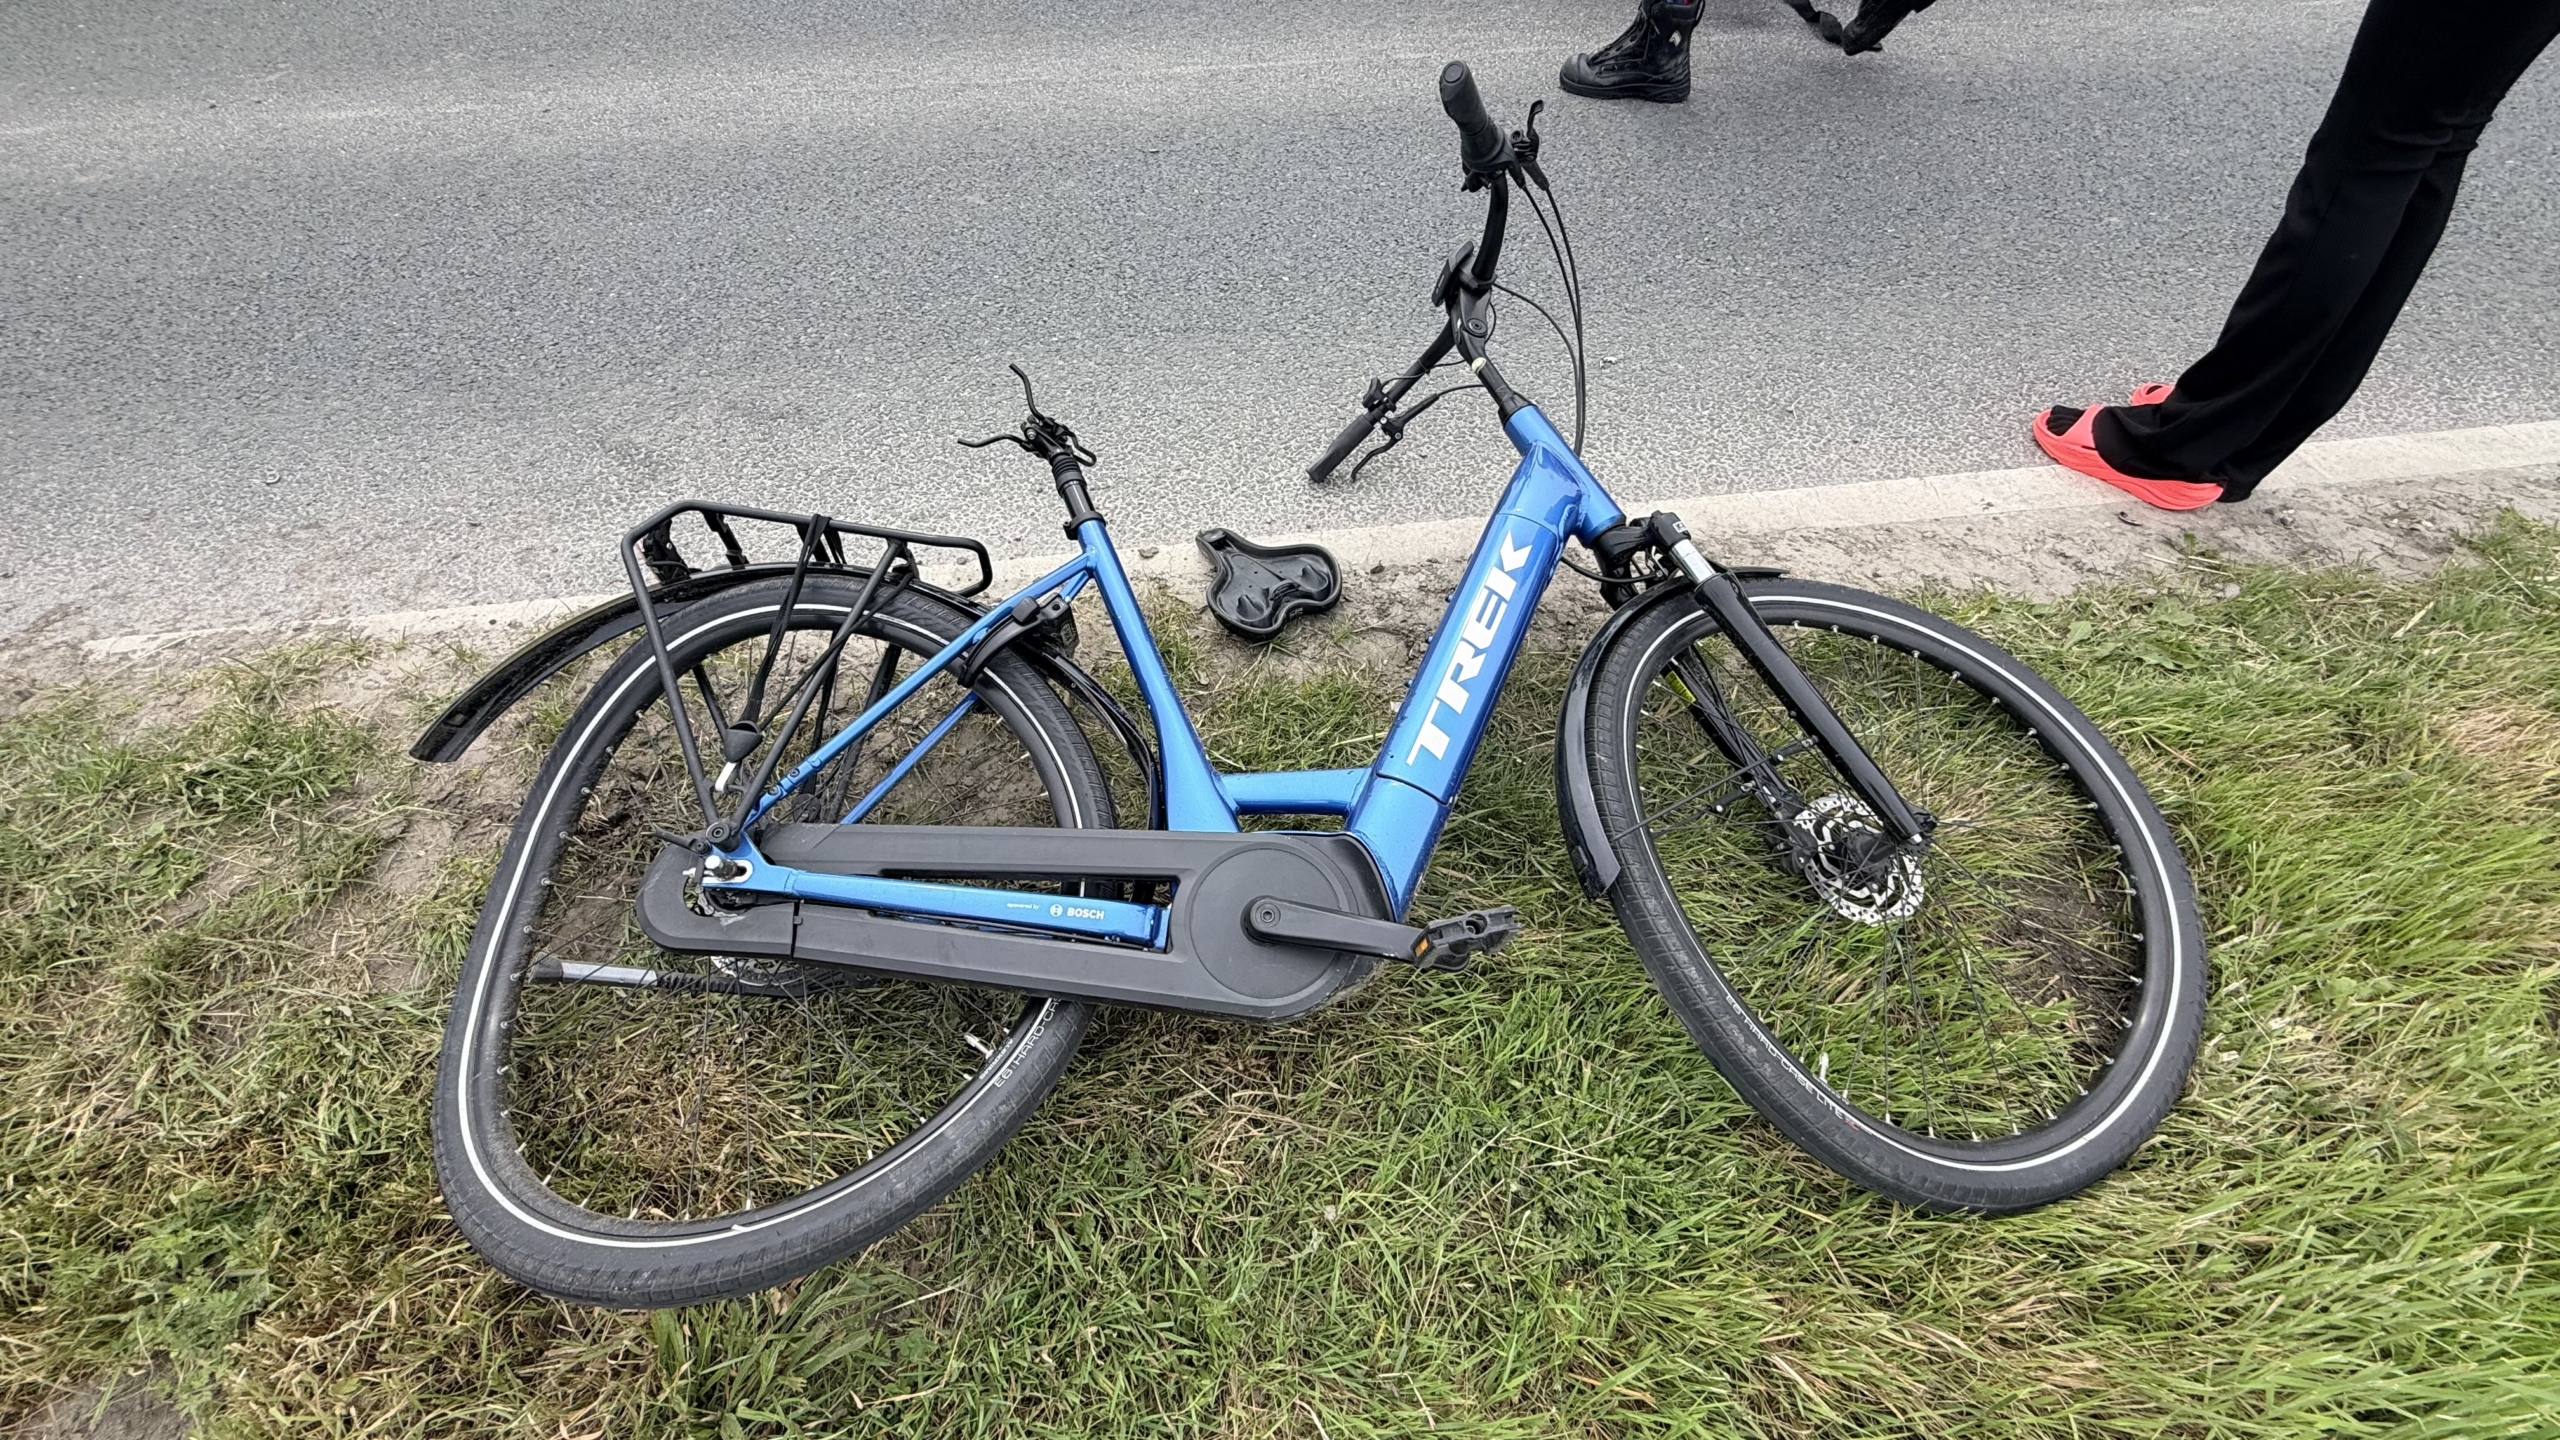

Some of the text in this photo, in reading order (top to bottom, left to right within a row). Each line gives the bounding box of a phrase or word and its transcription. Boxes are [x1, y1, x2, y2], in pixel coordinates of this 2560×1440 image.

[1406, 530, 1533, 766] TREK
[1067, 907, 1105, 920] BOSCH
[1816, 1091, 1844, 1120] LITE
